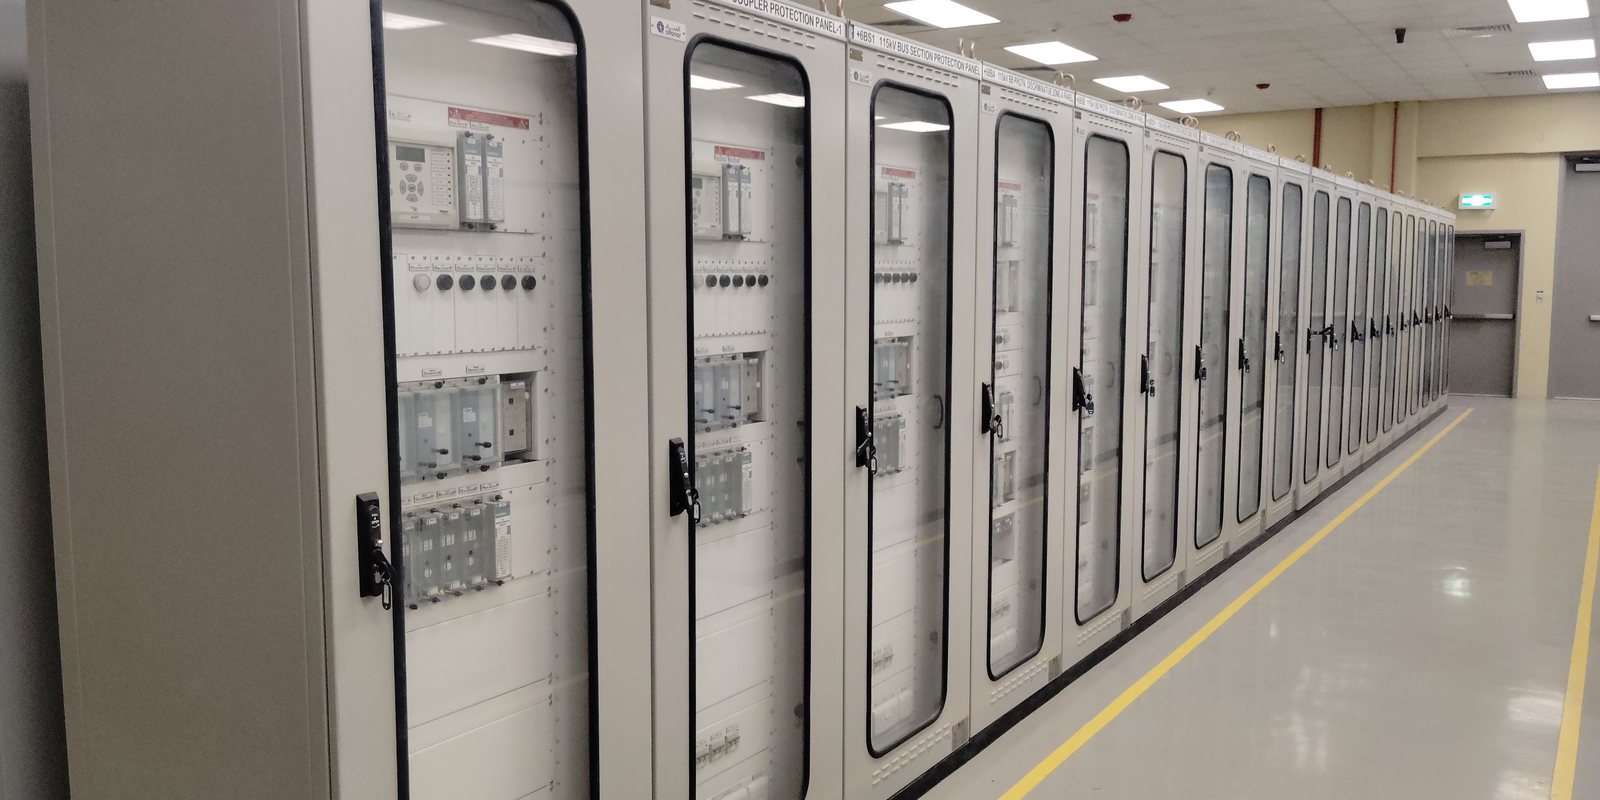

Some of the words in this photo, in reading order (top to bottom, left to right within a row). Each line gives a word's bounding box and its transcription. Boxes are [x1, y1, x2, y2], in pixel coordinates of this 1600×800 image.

[732, 0, 769, 13] UPLER
[770, 3, 815, 27] PROTECTION
[816, 18, 842, 35] PANEL-1
[856, 30, 875, 44] +6BS1
[879, 37, 896, 50] 115kV
[897, 41, 909, 54] BUS
[910, 46, 934, 61] SECTION
[934, 54, 965, 70] PROTECTION
[965, 62, 981, 76] PANEL
